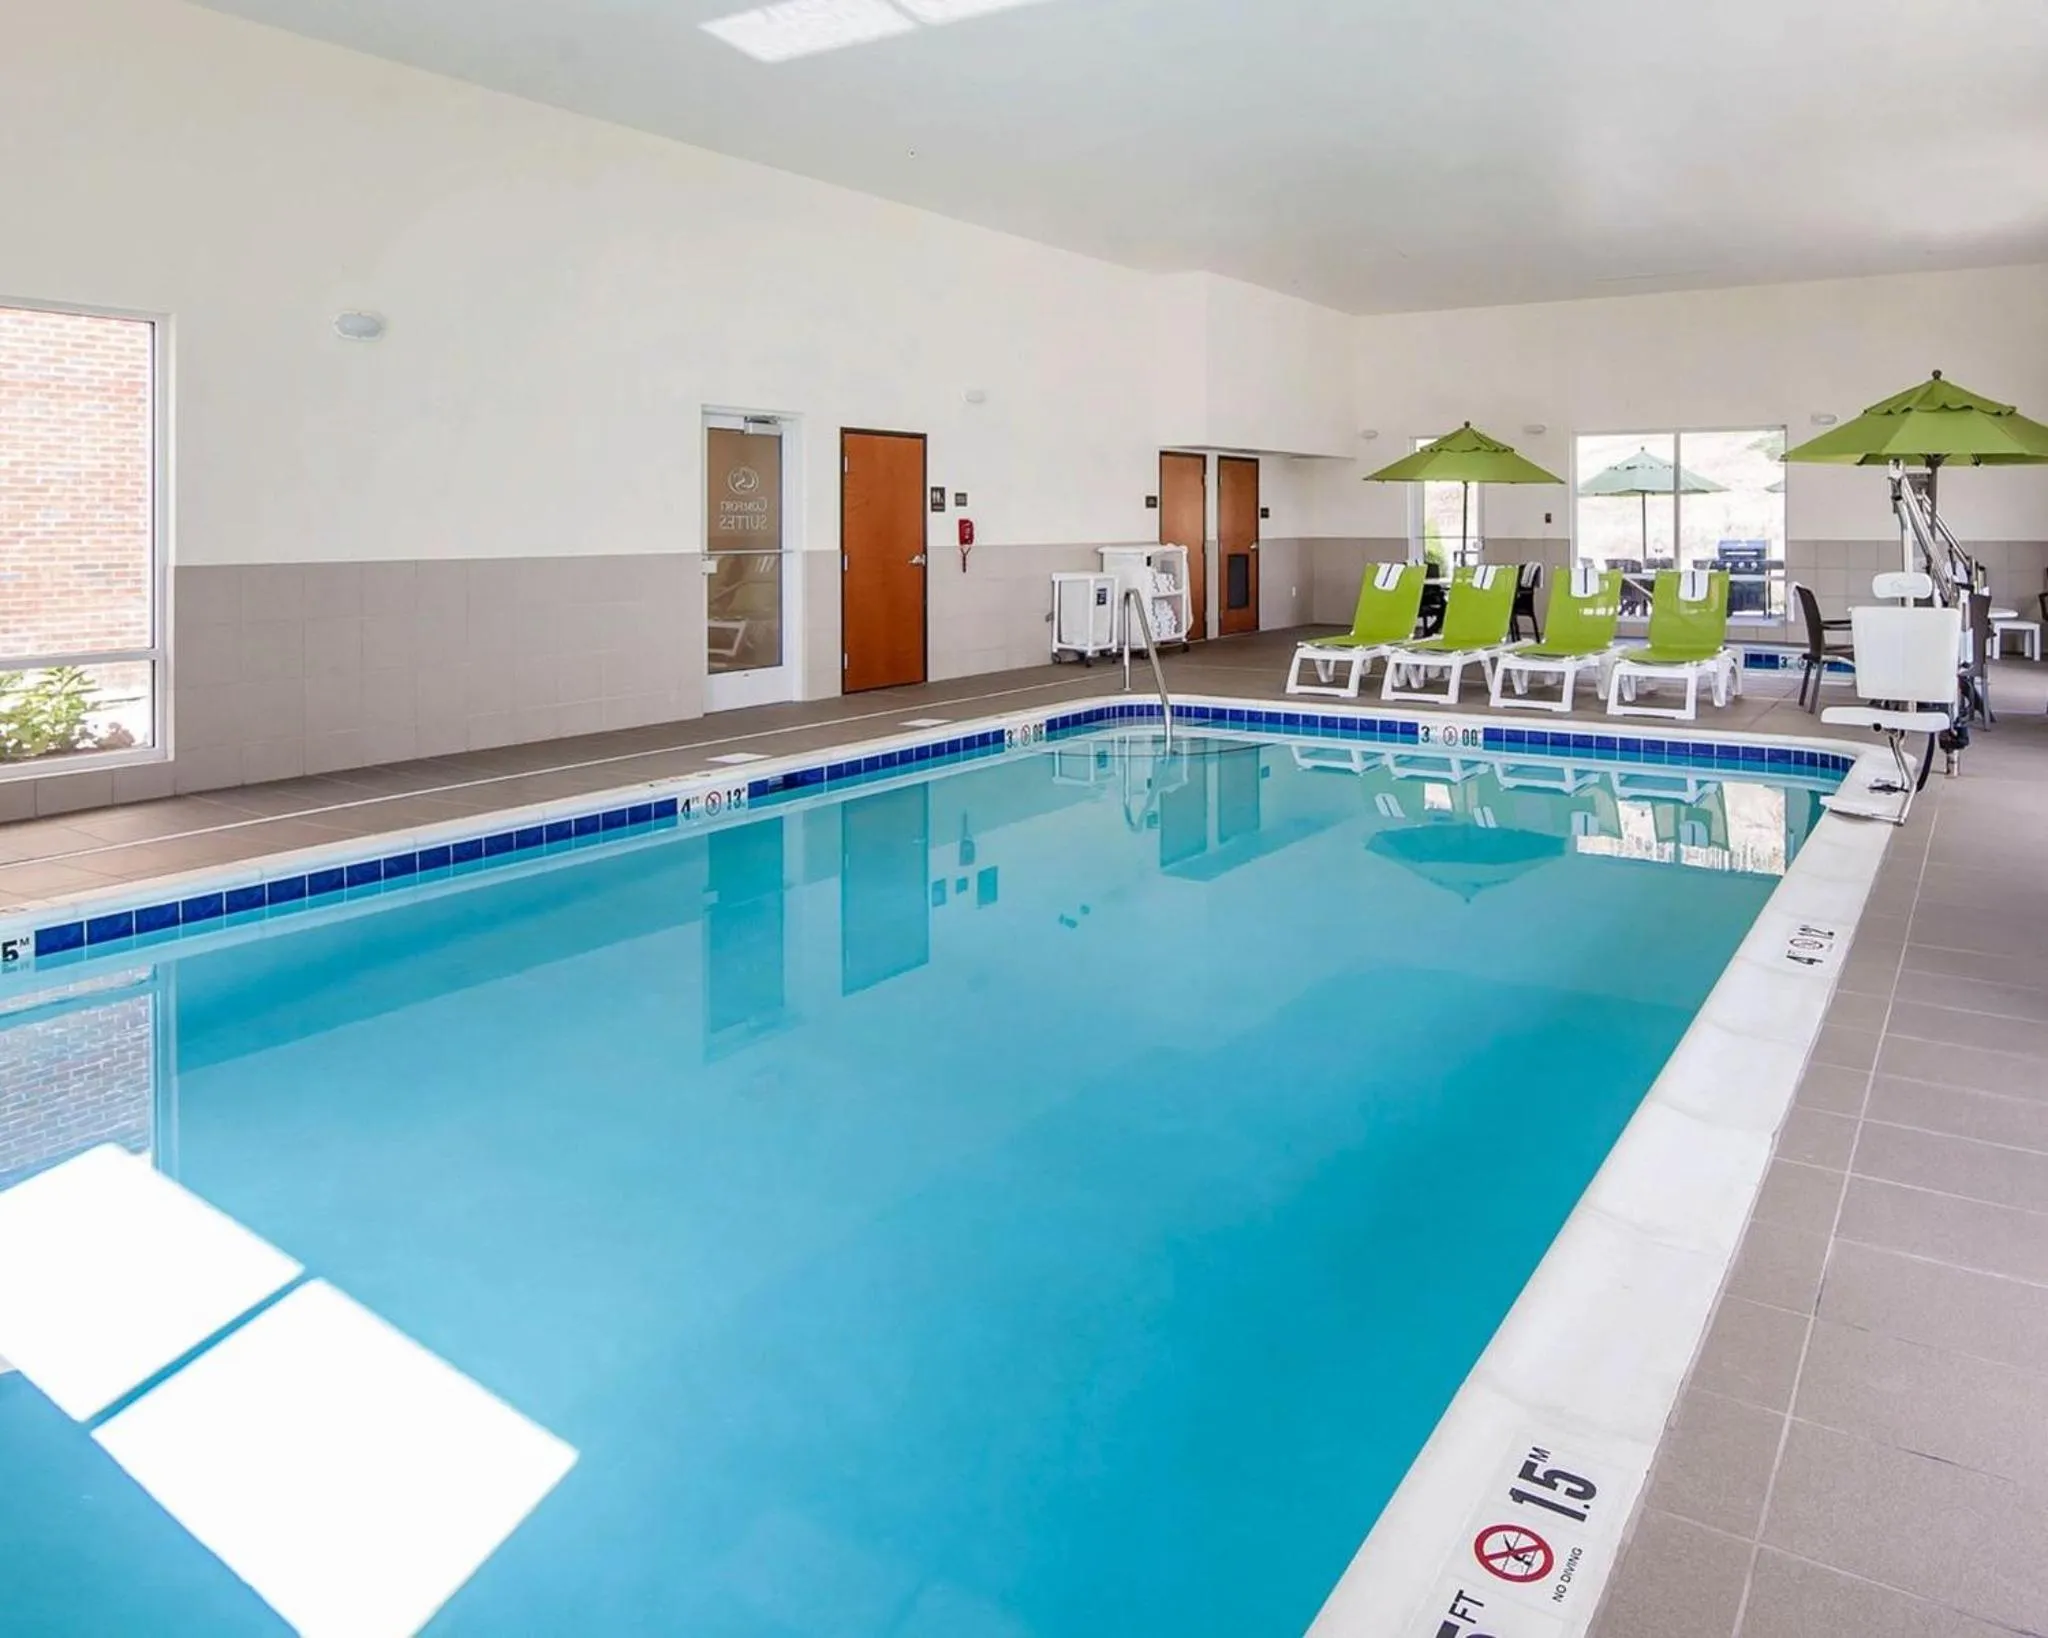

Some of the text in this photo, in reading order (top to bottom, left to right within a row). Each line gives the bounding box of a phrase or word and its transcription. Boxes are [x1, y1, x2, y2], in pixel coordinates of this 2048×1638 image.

[1552, 1547, 1583, 1602] NO DIVING
[1448, 1589, 1484, 1624] FT
